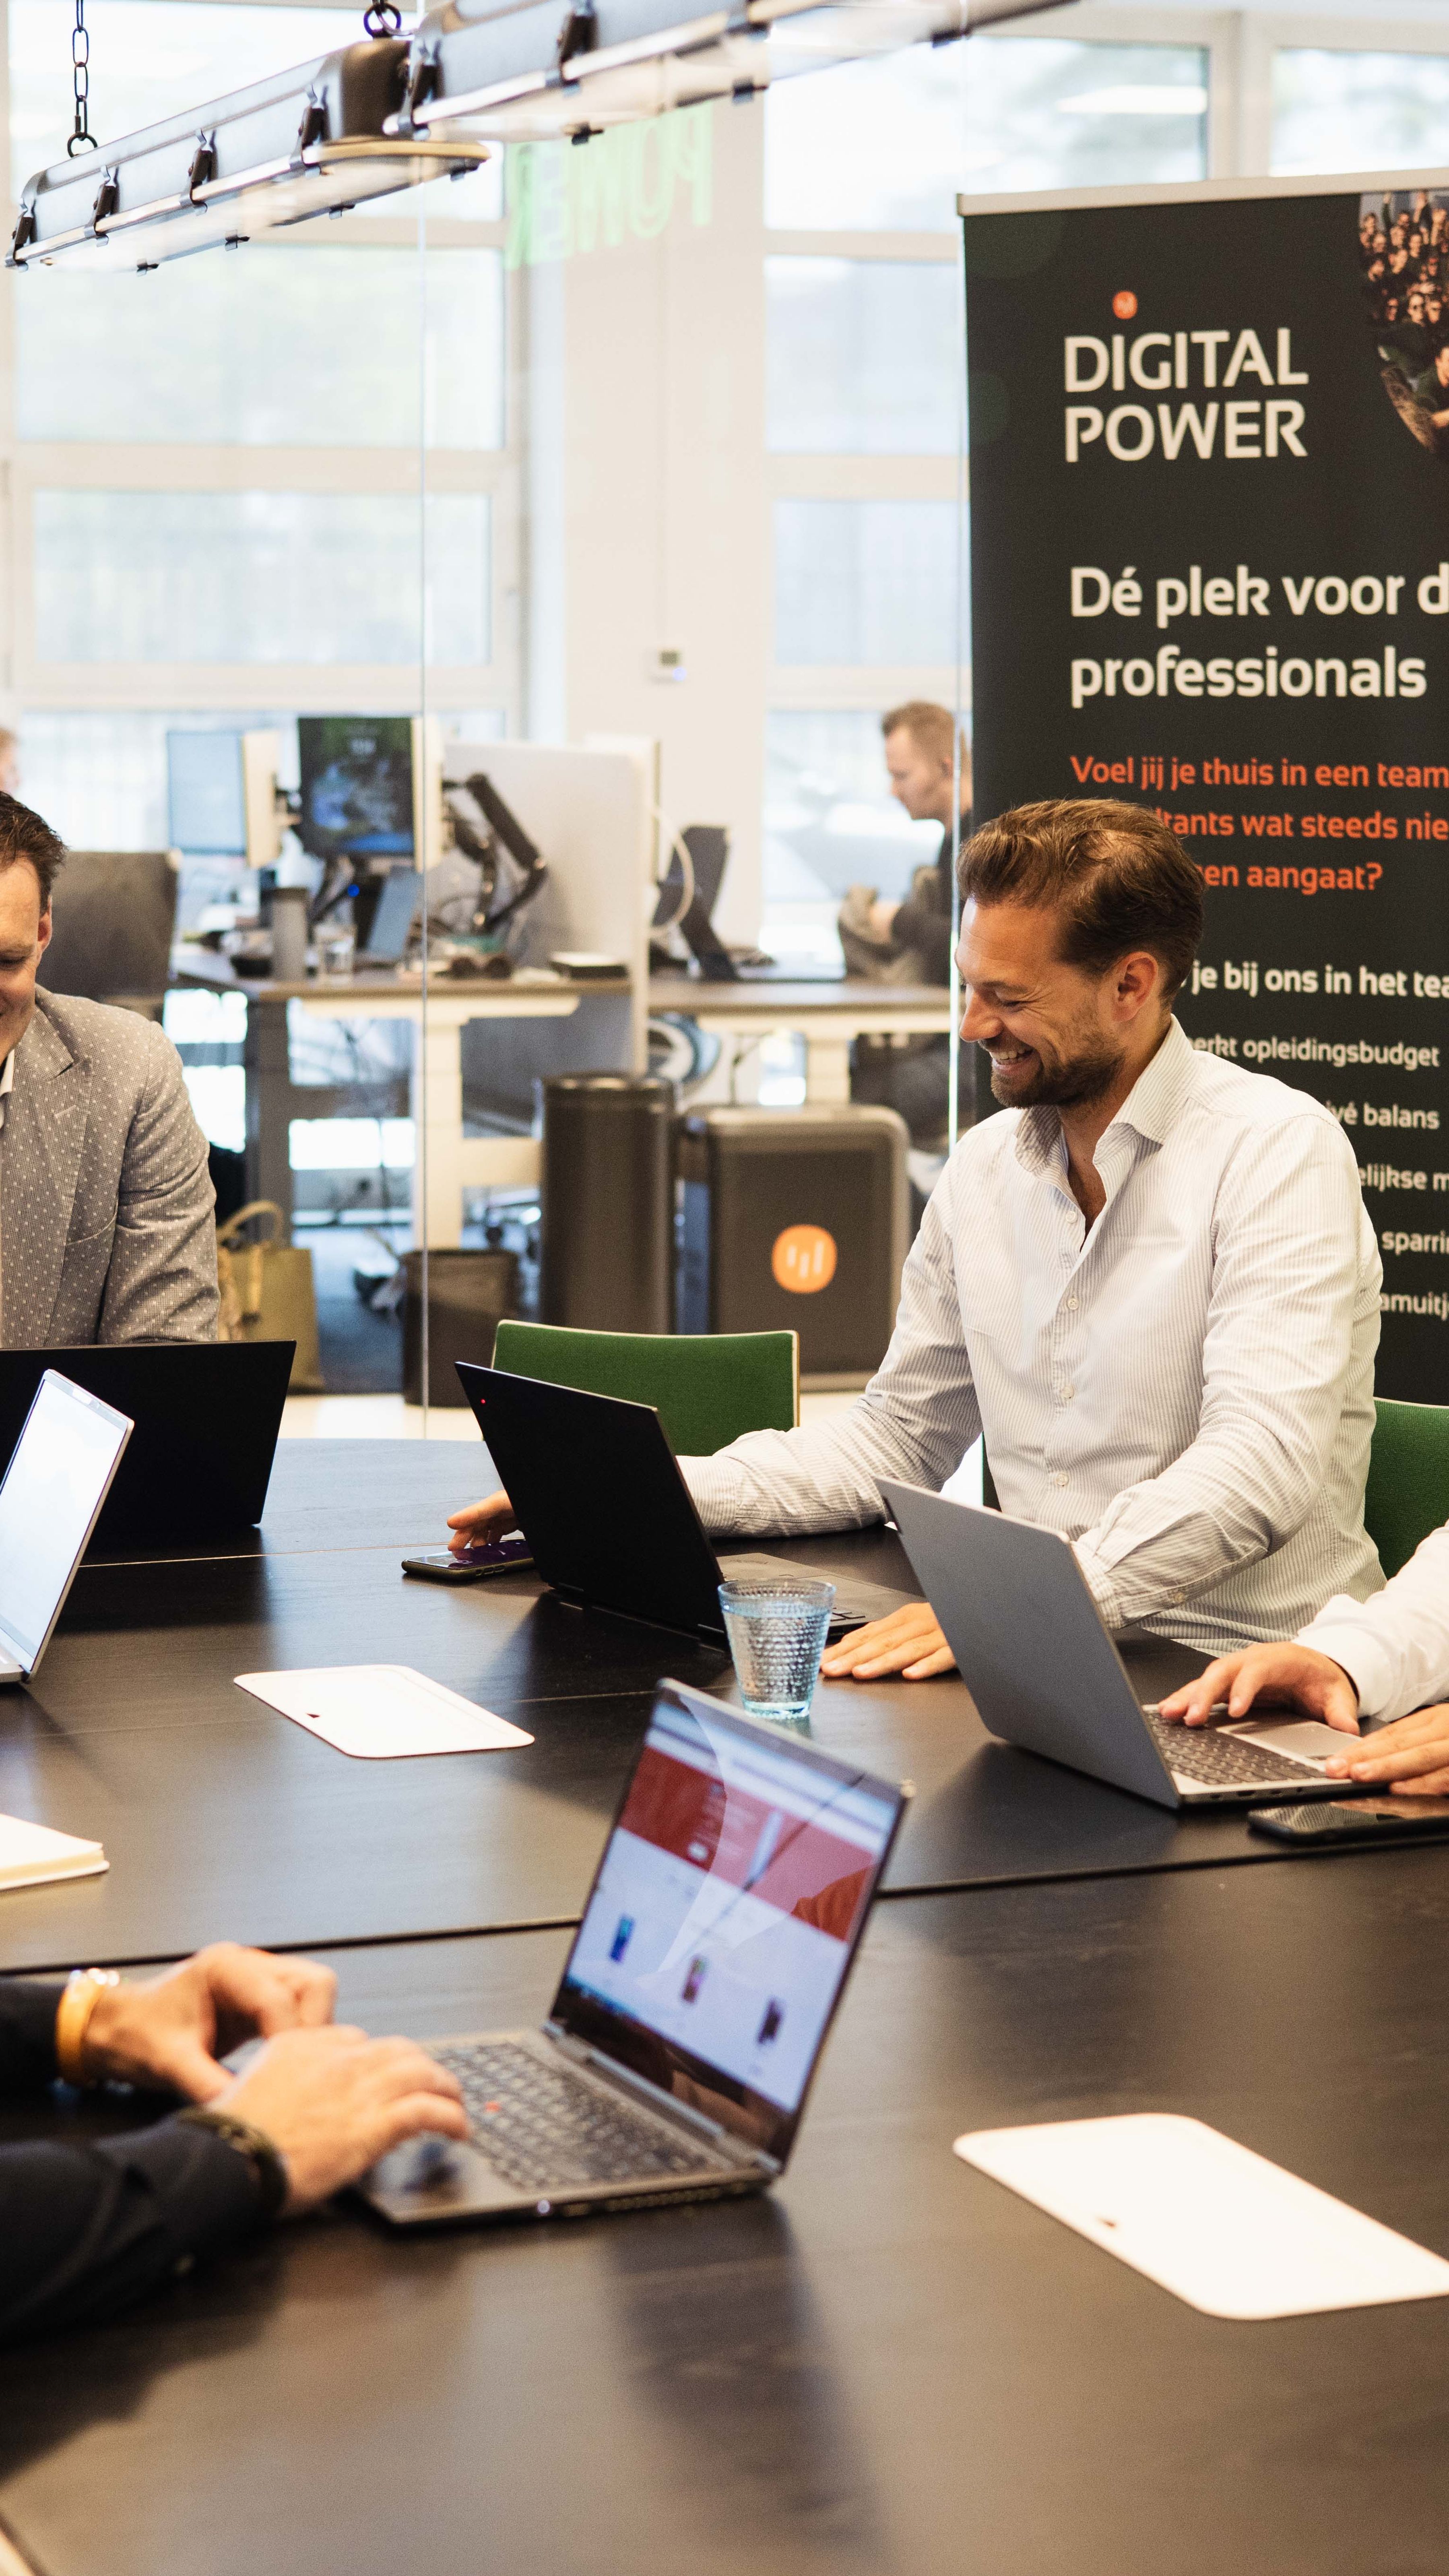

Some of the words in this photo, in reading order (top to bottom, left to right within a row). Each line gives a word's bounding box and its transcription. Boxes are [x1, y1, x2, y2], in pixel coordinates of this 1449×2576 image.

[1064, 327, 1309, 392] DIGITAL
[1065, 399, 1308, 463] POWER
[1071, 566, 1143, 617] Dé
[1156, 564, 1270, 629] plek
[1282, 576, 1406, 616] voor
[1071, 645, 1427, 709] professionals
[1070, 756, 1134, 783] Voel
[1141, 756, 1164, 791] jij
[1170, 757, 1196, 791] je
[1203, 757, 1274, 785] thuis
[1282, 758, 1307, 786] in
[1315, 765, 1369, 787] een
[1377, 763, 1449, 788] team
[1241, 813, 1294, 837] wat
[1301, 811, 1398, 839] steeds
[1406, 812, 1449, 840] nie
[1196, 865, 1239, 886] en
[1247, 862, 1383, 895] aangaat?
[1191, 960, 1218, 995] je
[1224, 961, 1258, 997] bij
[1264, 969, 1319, 993] ons
[1325, 964, 1352, 994] in
[1359, 965, 1408, 996] het
[1243, 1036, 1439, 1071] opleidingsbudget
[1363, 1103, 1440, 1130] balans
[1382, 1230, 1449, 1256] sparri
[1381, 1292, 1449, 1321] amuitj
